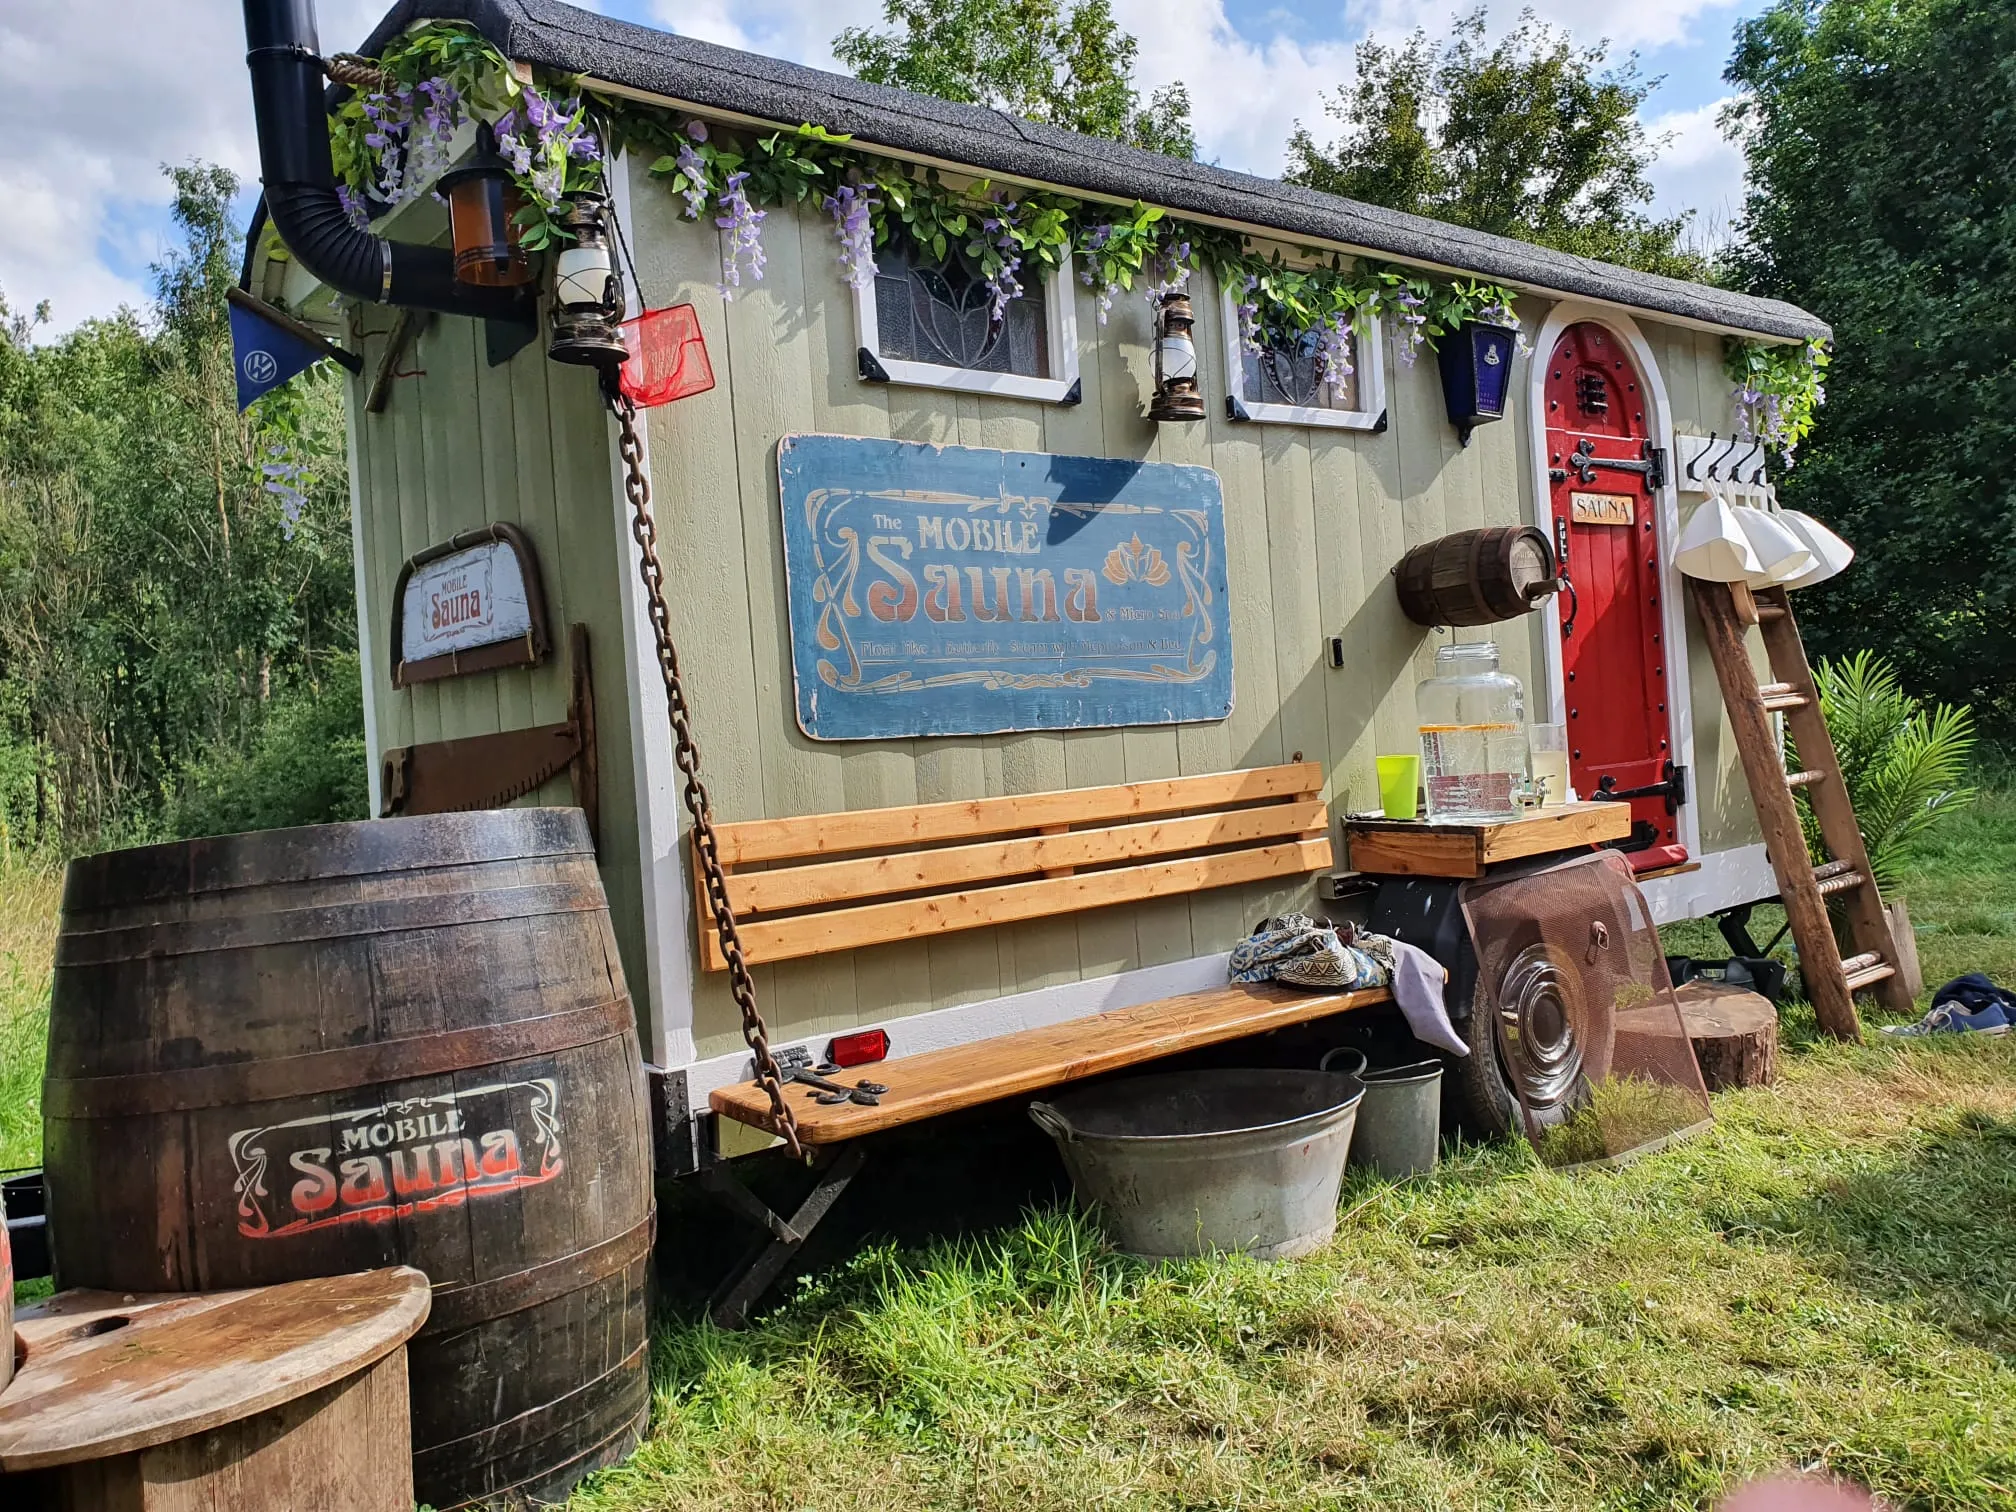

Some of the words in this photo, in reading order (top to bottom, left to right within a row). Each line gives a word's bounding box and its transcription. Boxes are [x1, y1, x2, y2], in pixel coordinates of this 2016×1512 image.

[1577, 498, 1630, 520] SAUNA
[872, 514, 902, 529] The
[917, 516, 1041, 554] MOBILE
[441, 574, 468, 595] MOBILE
[866, 535, 1103, 624] Sauna
[431, 589, 481, 630] Sauna
[1104, 608, 1117, 622] &
[340, 1109, 466, 1152] MOBILE
[289, 1129, 522, 1213] Sauna
